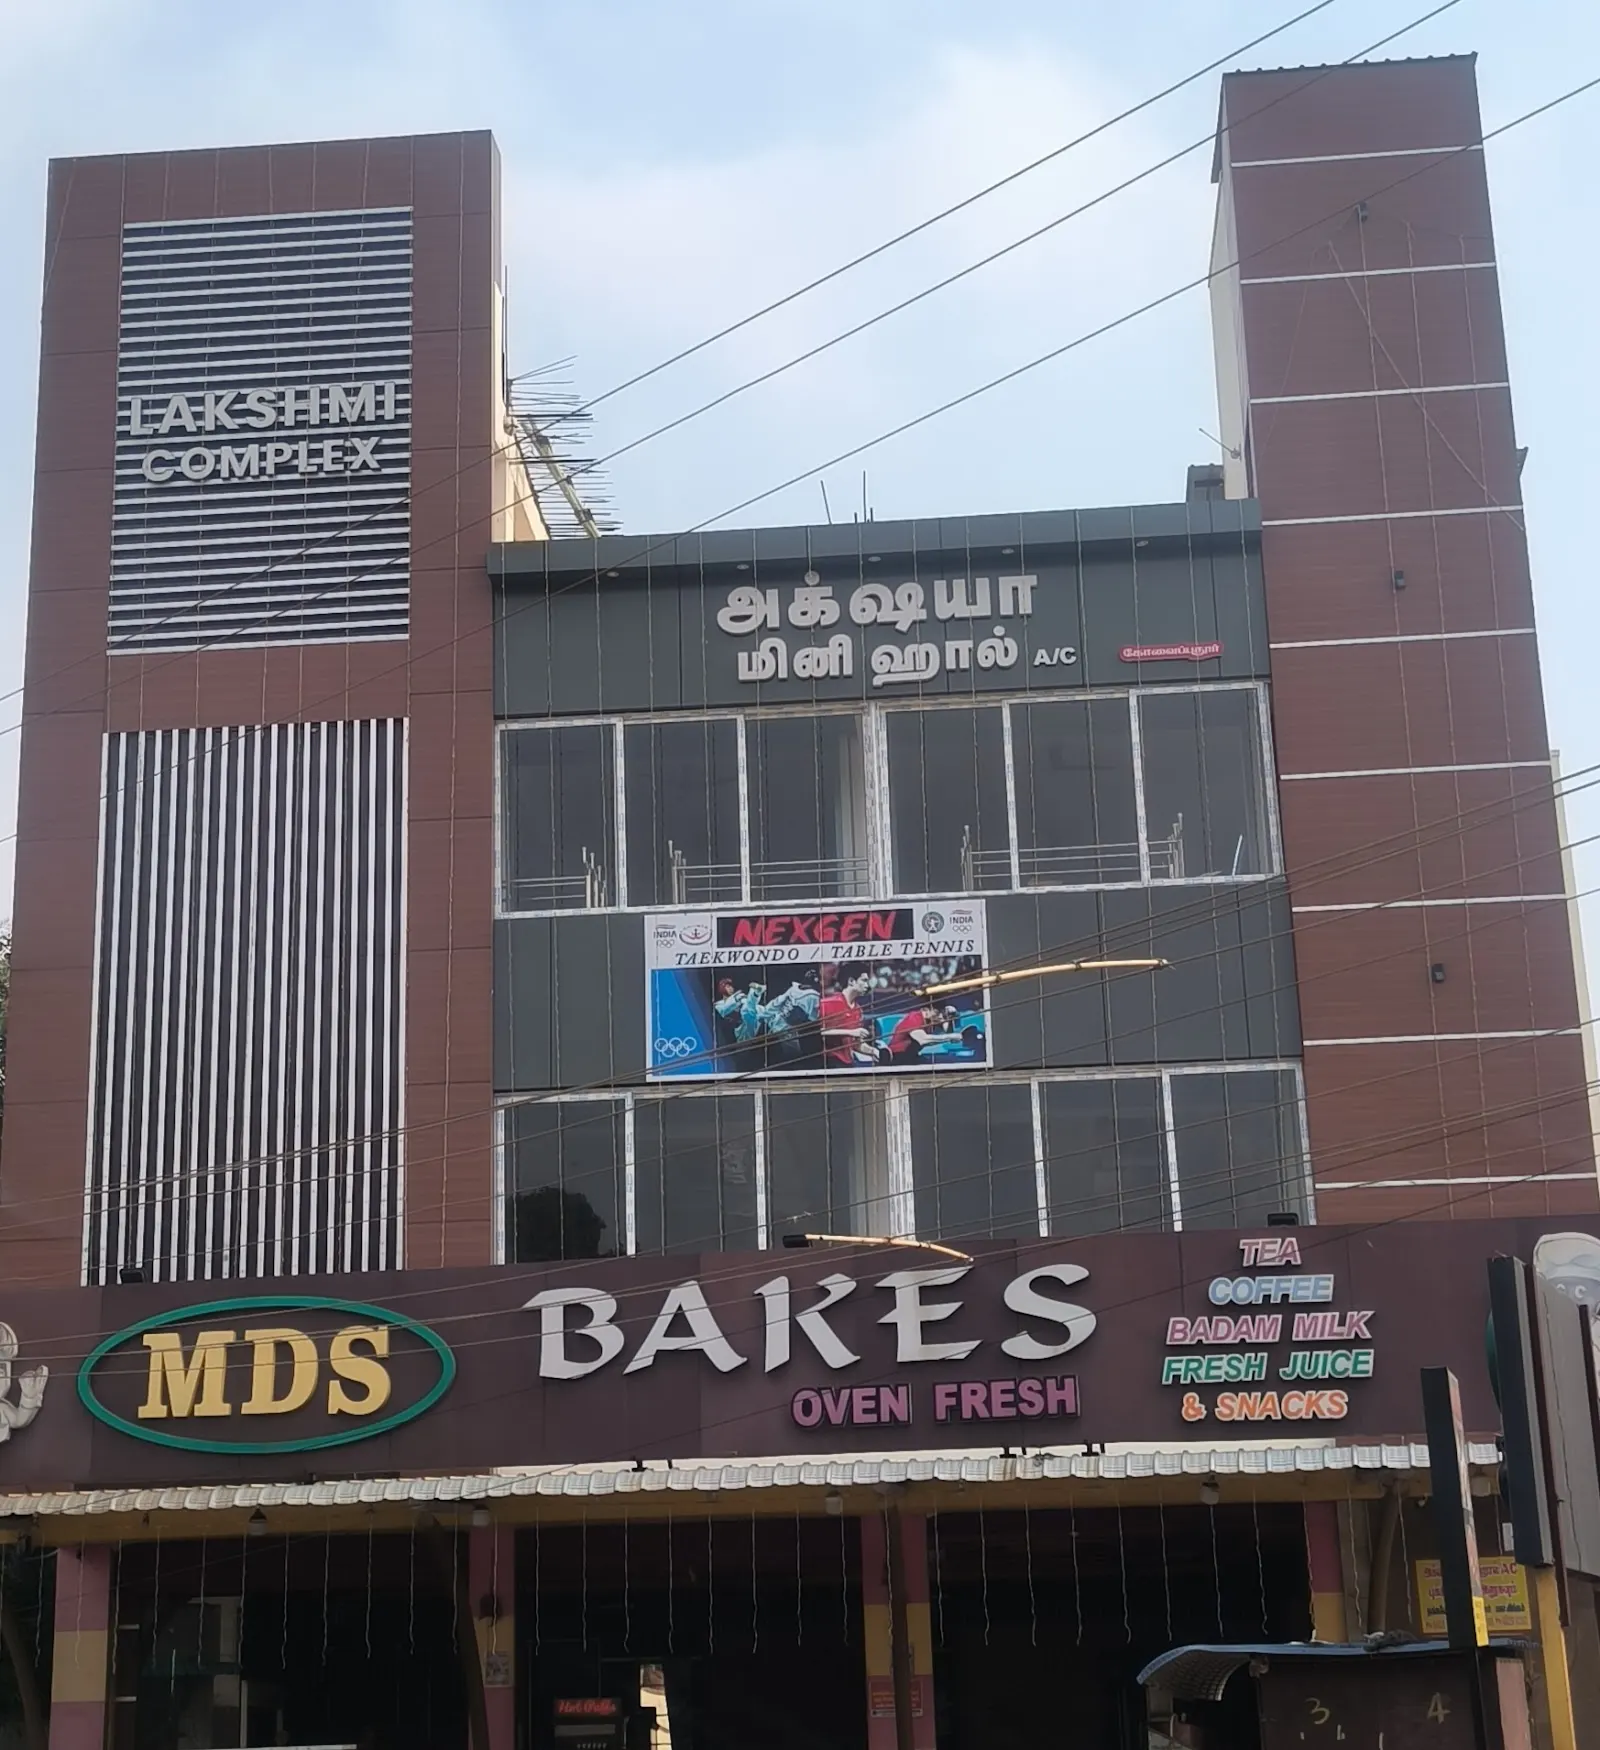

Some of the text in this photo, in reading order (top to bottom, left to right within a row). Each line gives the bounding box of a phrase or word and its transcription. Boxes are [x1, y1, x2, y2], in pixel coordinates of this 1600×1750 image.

[129, 382, 395, 436] LAKSHMI
[142, 437, 381, 481] COMPLEX
[737, 626, 1077, 687] மினி ஹால் A/C
[653, 930, 678, 940] INDIA
[733, 910, 896, 945] NEXGEN
[950, 915, 974, 925] INDIA
[675, 949, 799, 966] TAEKWONDO
[831, 944, 892, 959] TABLE
[902, 940, 975, 955] TENNIS
[1239, 1236, 1302, 1267] TEA
[1208, 1273, 1334, 1306] COFFEE
[138, 1263, 1097, 1419] MDS BAKES
[1165, 1310, 1376, 1346] BADAM MILK
[1161, 1348, 1375, 1385] FRESH JUICE
[791, 1375, 1079, 1428] OVEN FRESH
[1181, 1390, 1348, 1422] & SNACKS
[1305, 1697, 1330, 1724] 3
[1427, 1692, 1451, 1724] 4
